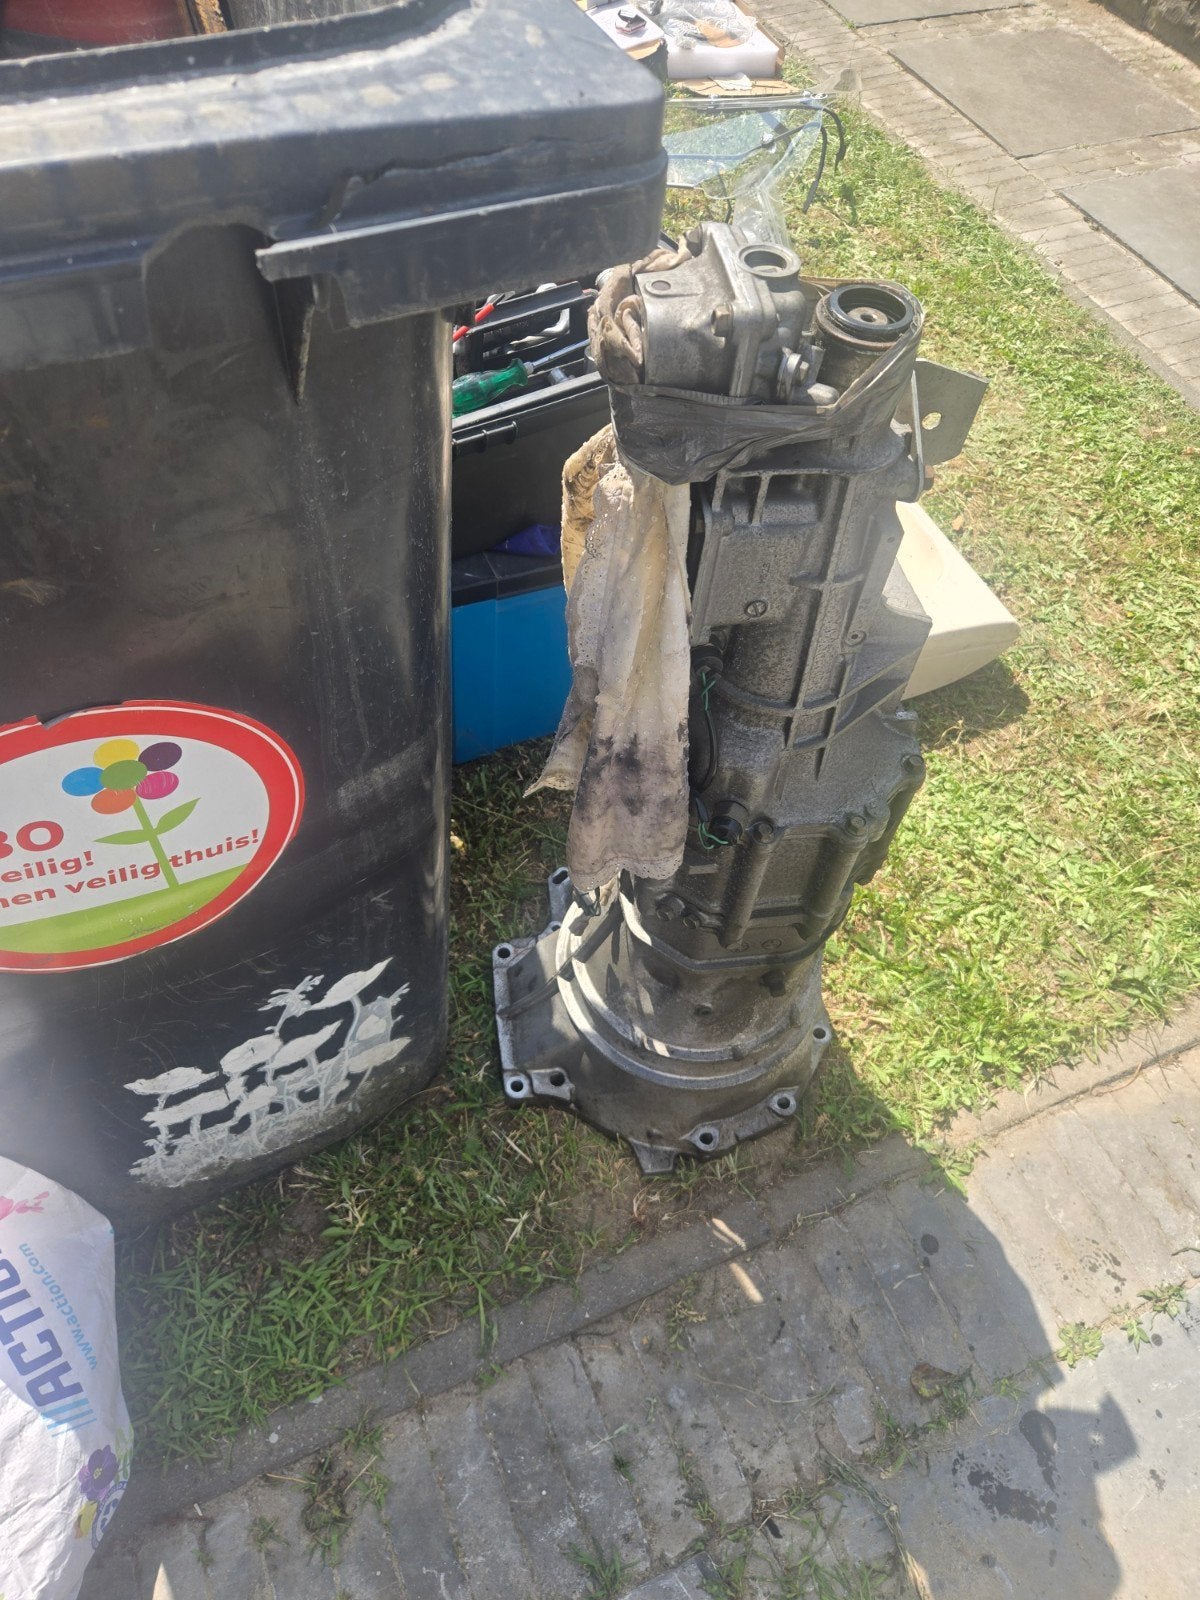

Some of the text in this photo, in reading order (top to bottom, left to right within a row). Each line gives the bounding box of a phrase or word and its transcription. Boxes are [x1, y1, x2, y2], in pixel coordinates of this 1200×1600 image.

[64, 863, 160, 894] veilig
[169, 829, 259, 868] thuis!
[18, 1243, 98, 1371] www.action.com
